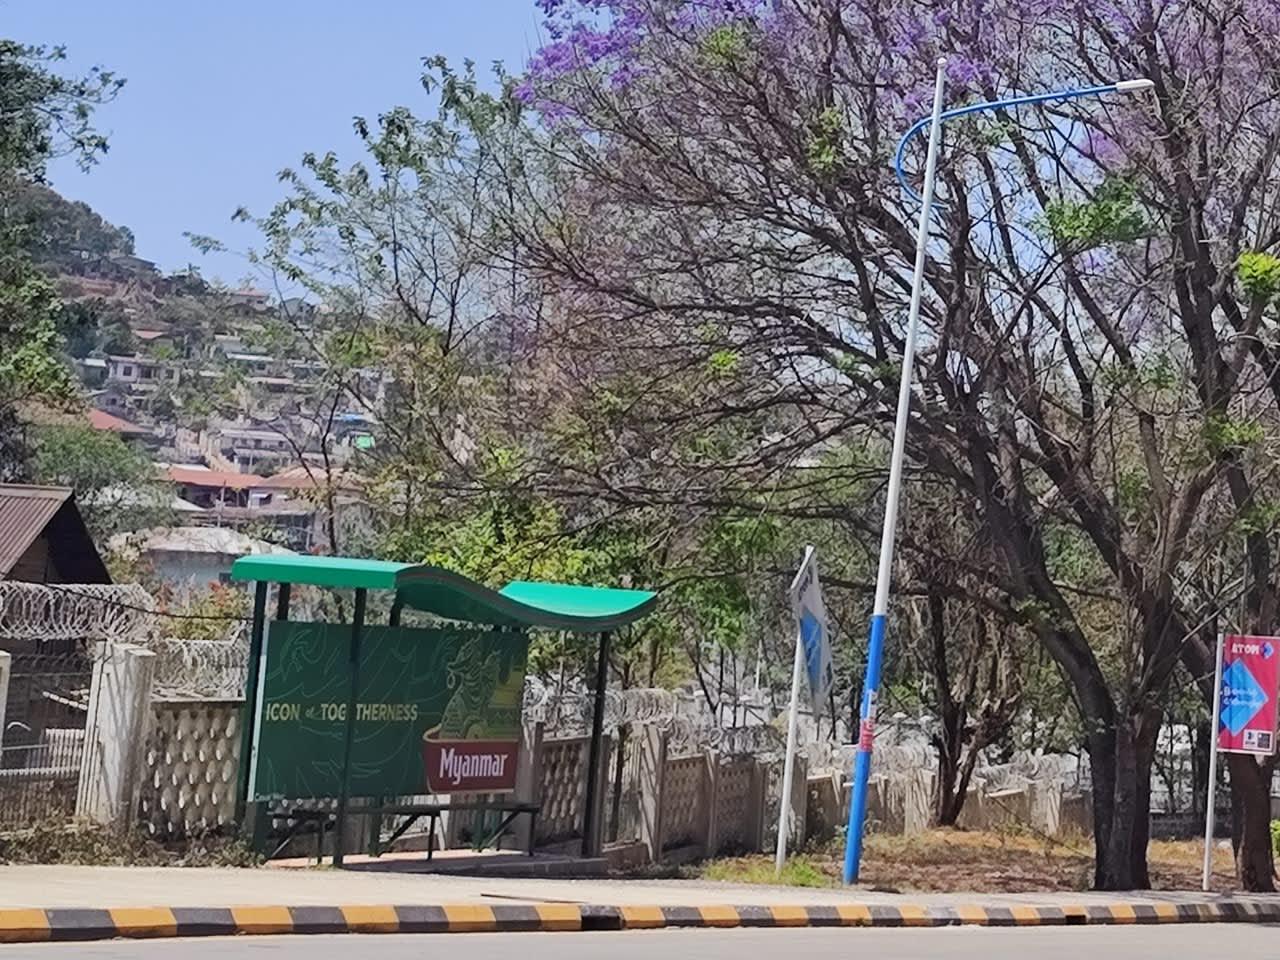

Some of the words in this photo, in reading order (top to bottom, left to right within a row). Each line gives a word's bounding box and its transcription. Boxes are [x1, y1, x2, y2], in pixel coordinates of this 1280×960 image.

[1232, 643, 1260, 655] ATOM
[266, 703, 300, 721] ICON
[321, 703, 418, 721] TOGTHERNESS
[440, 747, 508, 785] Myanmar
